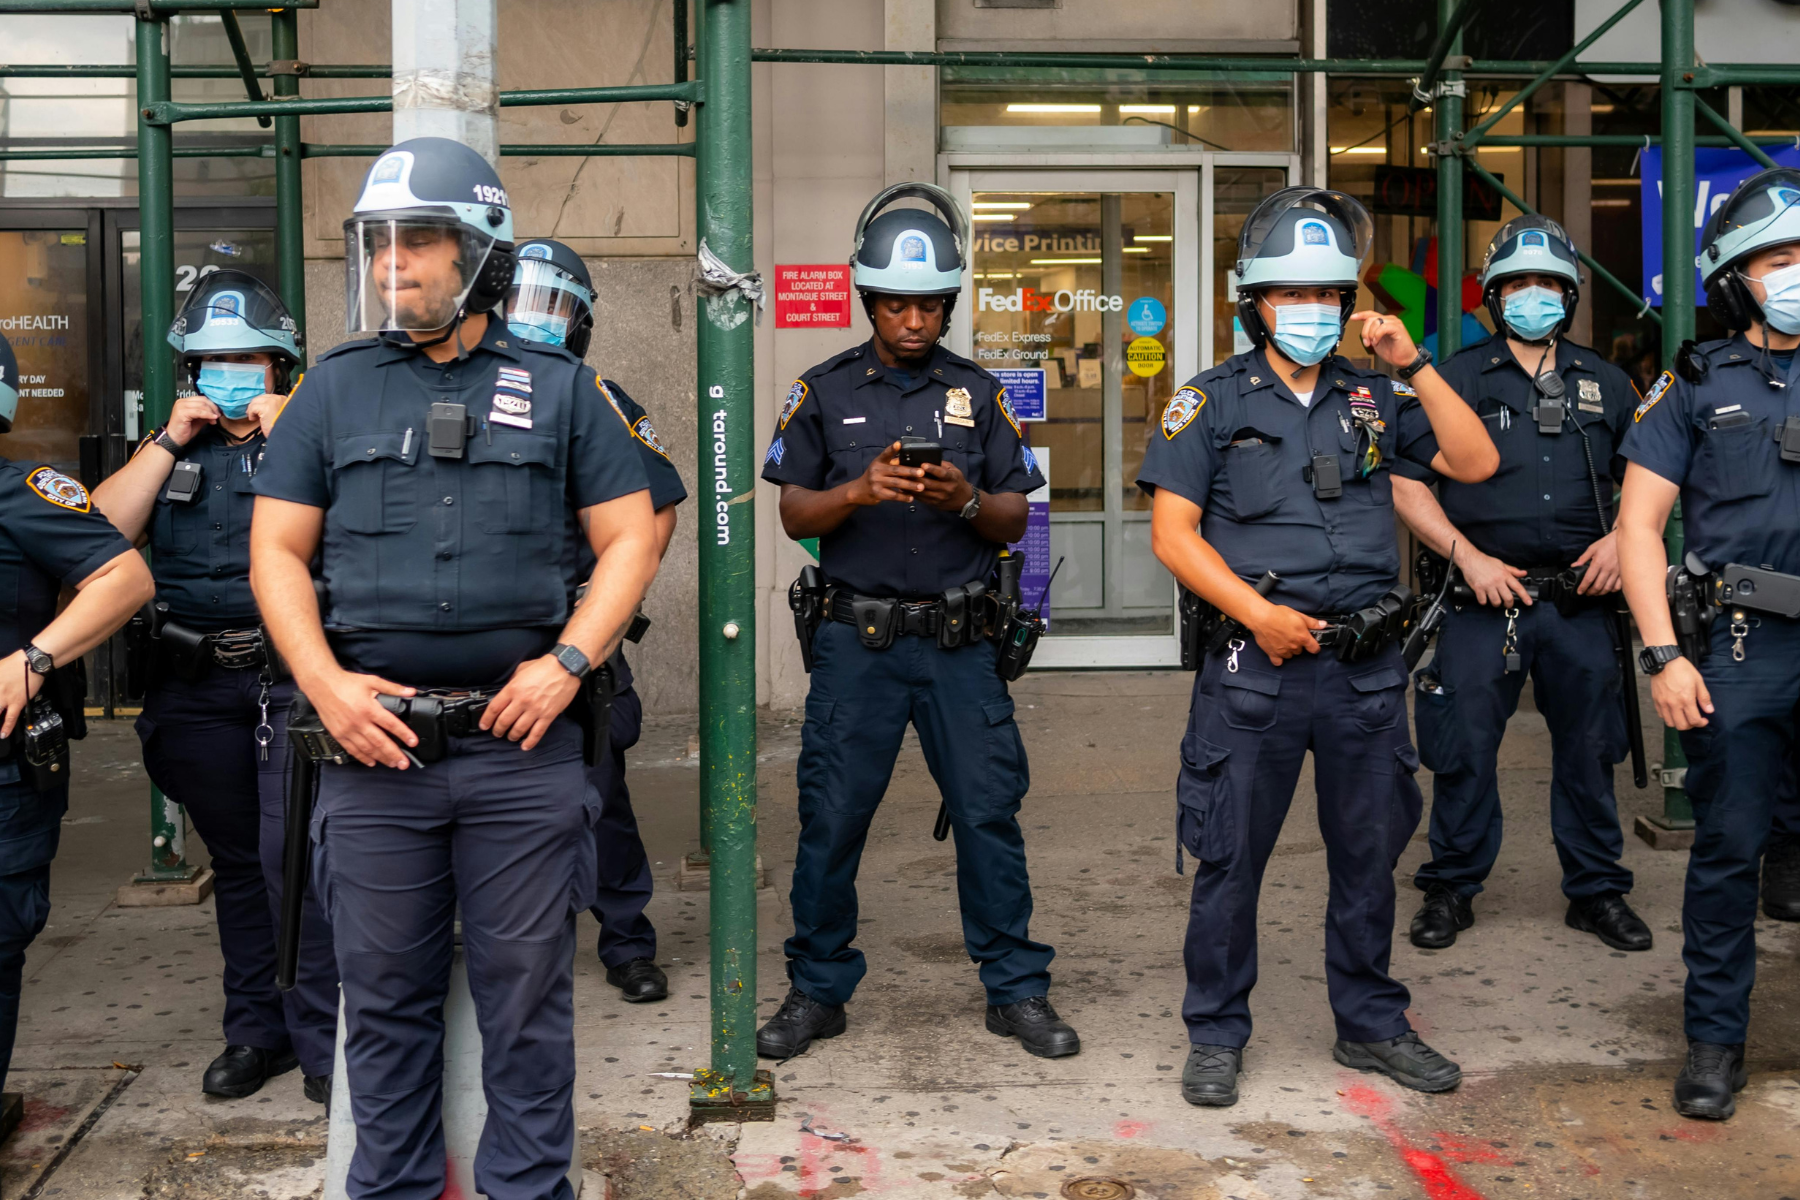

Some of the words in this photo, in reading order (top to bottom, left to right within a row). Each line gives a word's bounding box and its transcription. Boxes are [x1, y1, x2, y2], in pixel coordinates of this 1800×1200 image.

[1381, 171, 1494, 214] OPN
[1024, 233, 1101, 252] Printi
[782, 271, 798, 279] FIRE
[800, 271, 826, 279] ALARM
[828, 271, 843, 279] BOX
[791, 282, 823, 290] LOCATED
[825, 282, 834, 290] AT
[778, 292, 819, 301] MONTAGUE
[820, 292, 847, 300] STREET
[978, 288, 1052, 311] FedEx
[1054, 289, 1123, 311] Office
[810, 303, 816, 311] &
[786, 313, 811, 322] COURT
[812, 313, 840, 321] STREET
[8, 336, 36, 347] GENT
[978, 332, 1009, 342] FedEx
[1012, 332, 1051, 344] Express
[978, 349, 1009, 360] FedEx
[1012, 349, 1048, 360] Ground
[29, 375, 46, 384] DAY
[31, 389, 64, 397] NEEDED
[713, 409, 732, 545] taround.com
